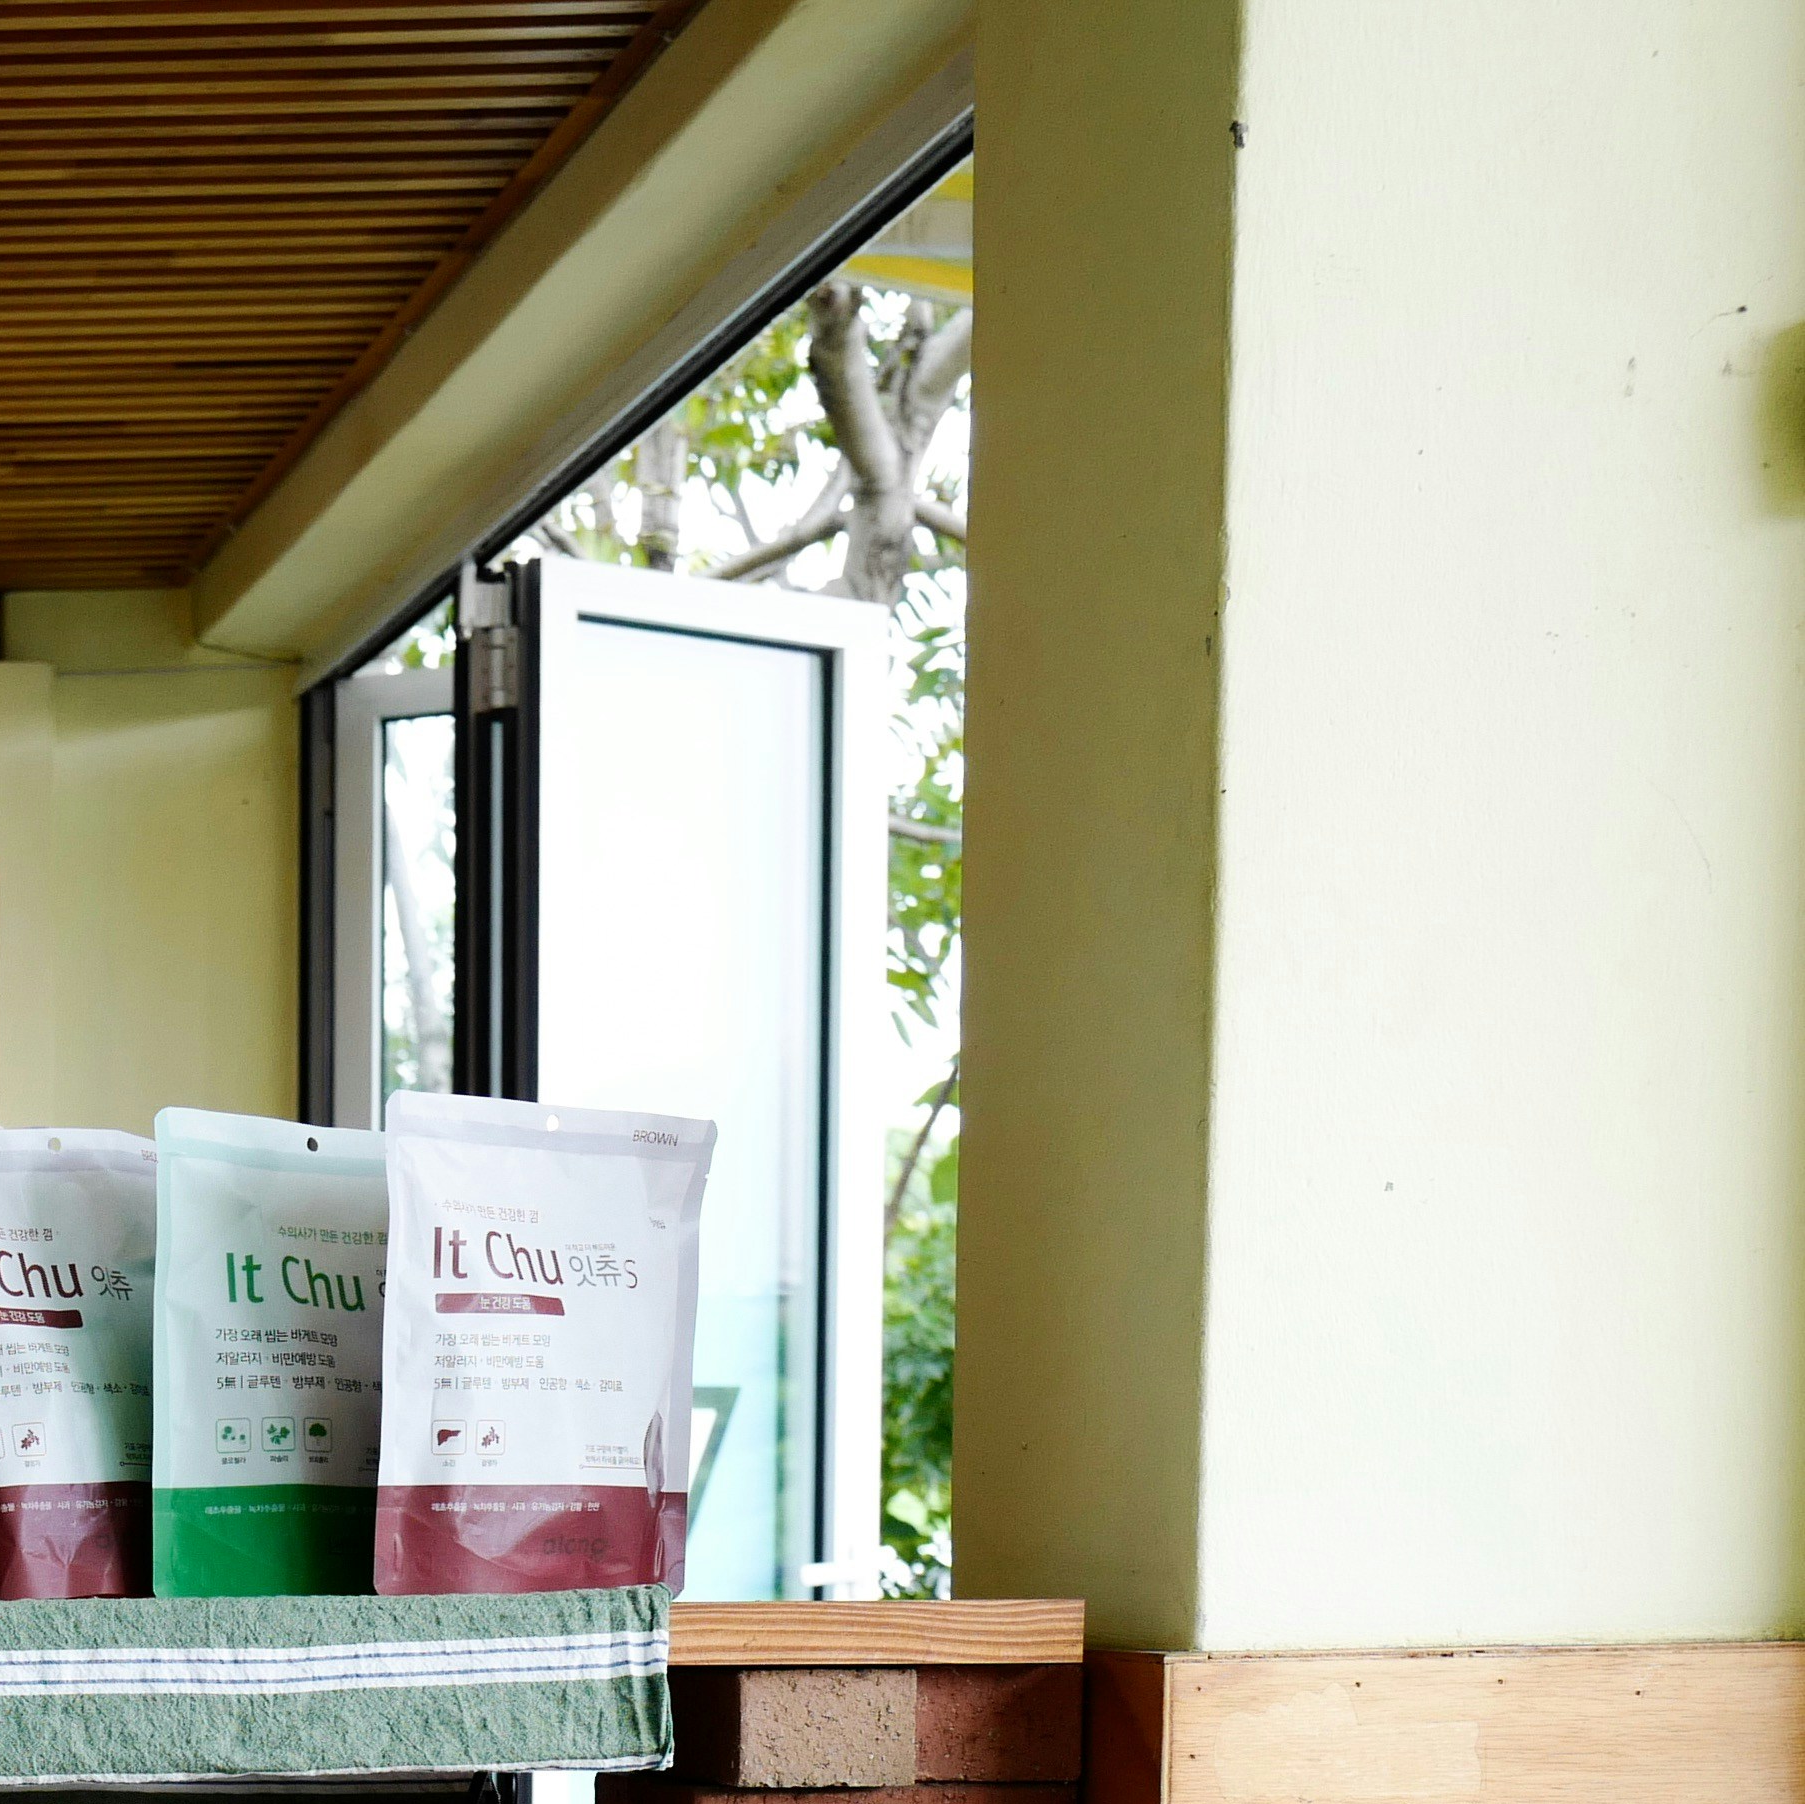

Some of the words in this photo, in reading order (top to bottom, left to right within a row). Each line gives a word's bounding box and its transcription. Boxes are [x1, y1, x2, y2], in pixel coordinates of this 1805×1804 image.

[633, 1130, 678, 1147] BROWN
[10, 1229, 39, 1241] 건강한
[43, 1228, 53, 1241] 껌
[279, 1226, 317, 1241] 수의사가
[320, 1228, 338, 1242] 만든
[342, 1231, 373, 1245] 건강한
[434, 1227, 468, 1278] It
[486, 1231, 564, 1285] Chu
[91, 1265, 133, 1300] 잇츄
[227, 1252, 264, 1304] It
[282, 1256, 365, 1311] Chu
[480, 1297, 491, 1308] 눈
[493, 1297, 511, 1310] 건강
[513, 1297, 531, 1310] 도움
[216, 1329, 237, 1342] 가장
[241, 1329, 262, 1342] 오래
[265, 1329, 288, 1343] 씹는
[217, 1352, 261, 1366] 저알러지
[272, 1353, 317, 1366] 비만예방
